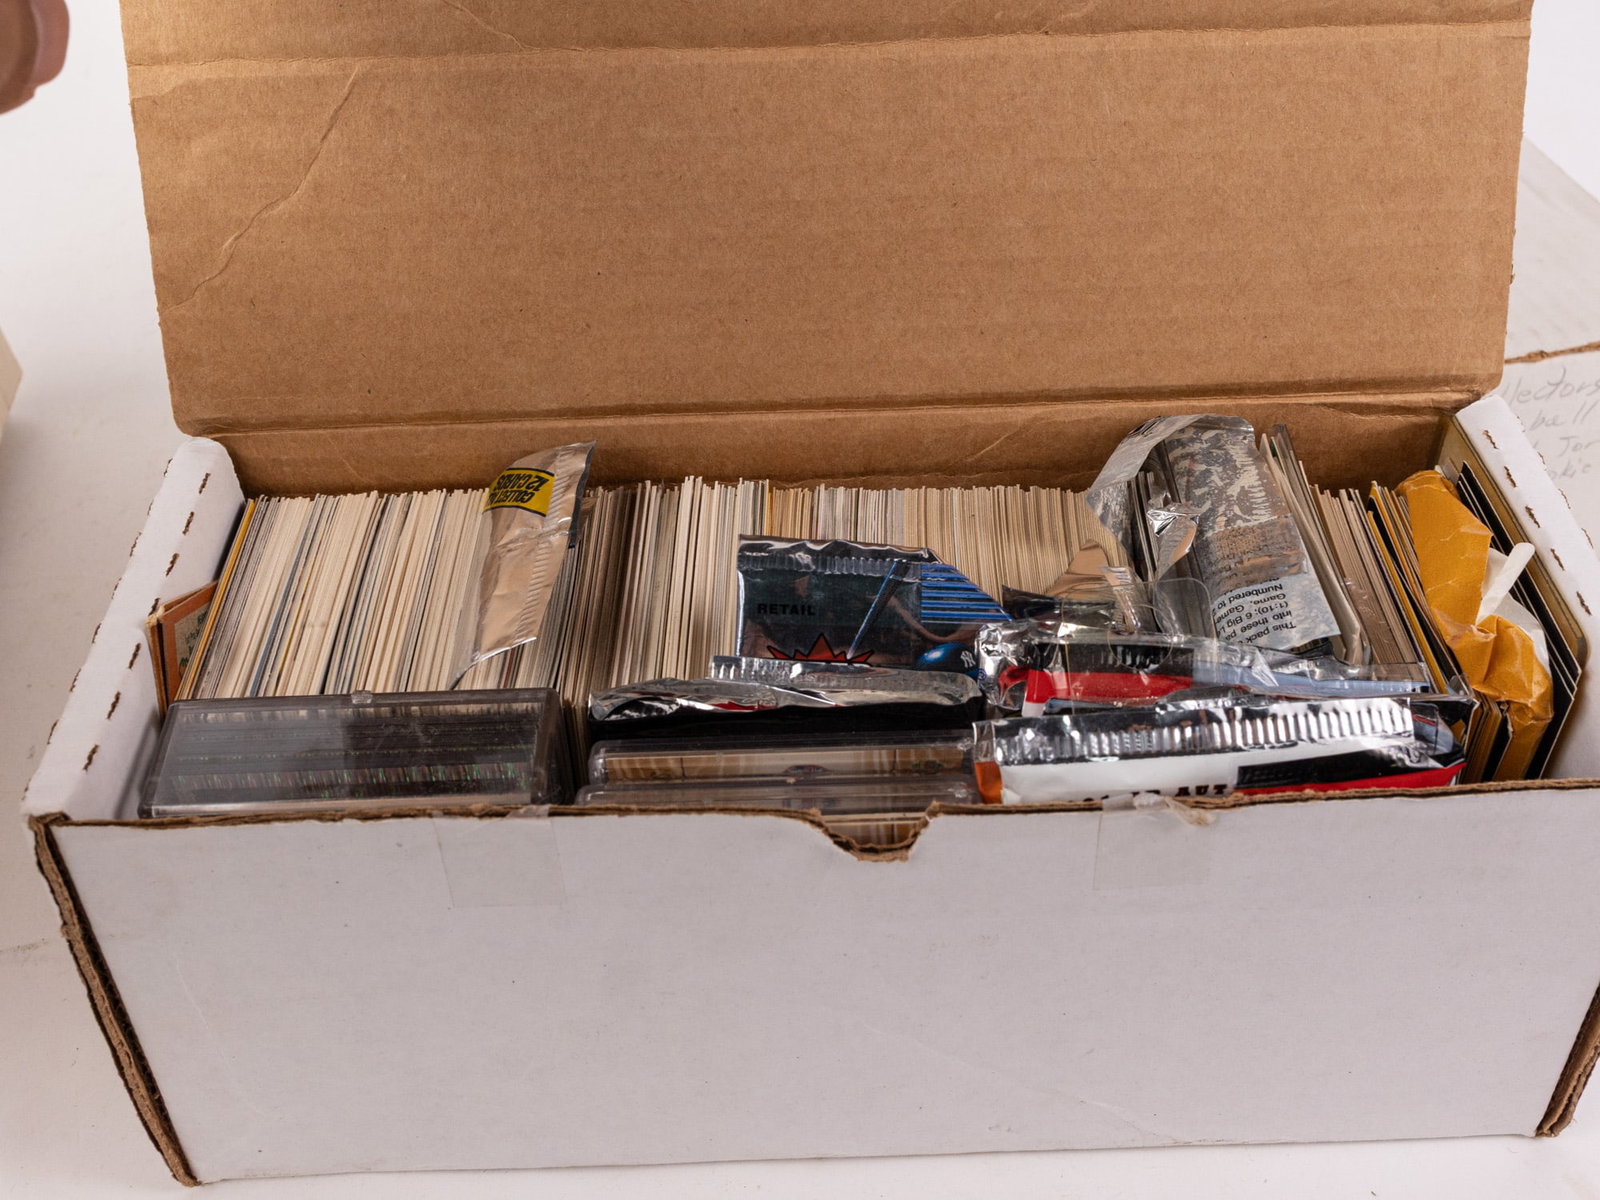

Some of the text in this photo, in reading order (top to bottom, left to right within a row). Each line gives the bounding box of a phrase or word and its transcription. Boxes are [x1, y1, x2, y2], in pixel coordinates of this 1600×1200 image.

[1558, 436, 1600, 457] Jor
[495, 474, 549, 492] 12 CARDS
[1228, 583, 1283, 604] Numbered
[757, 602, 816, 616] RETAIL
[1217, 600, 1226, 609] to
[1226, 615, 1243, 628] Big
[1245, 612, 1253, 620] 6
[1225, 610, 1292, 642] into these pa
[1245, 621, 1296, 644] This pack
